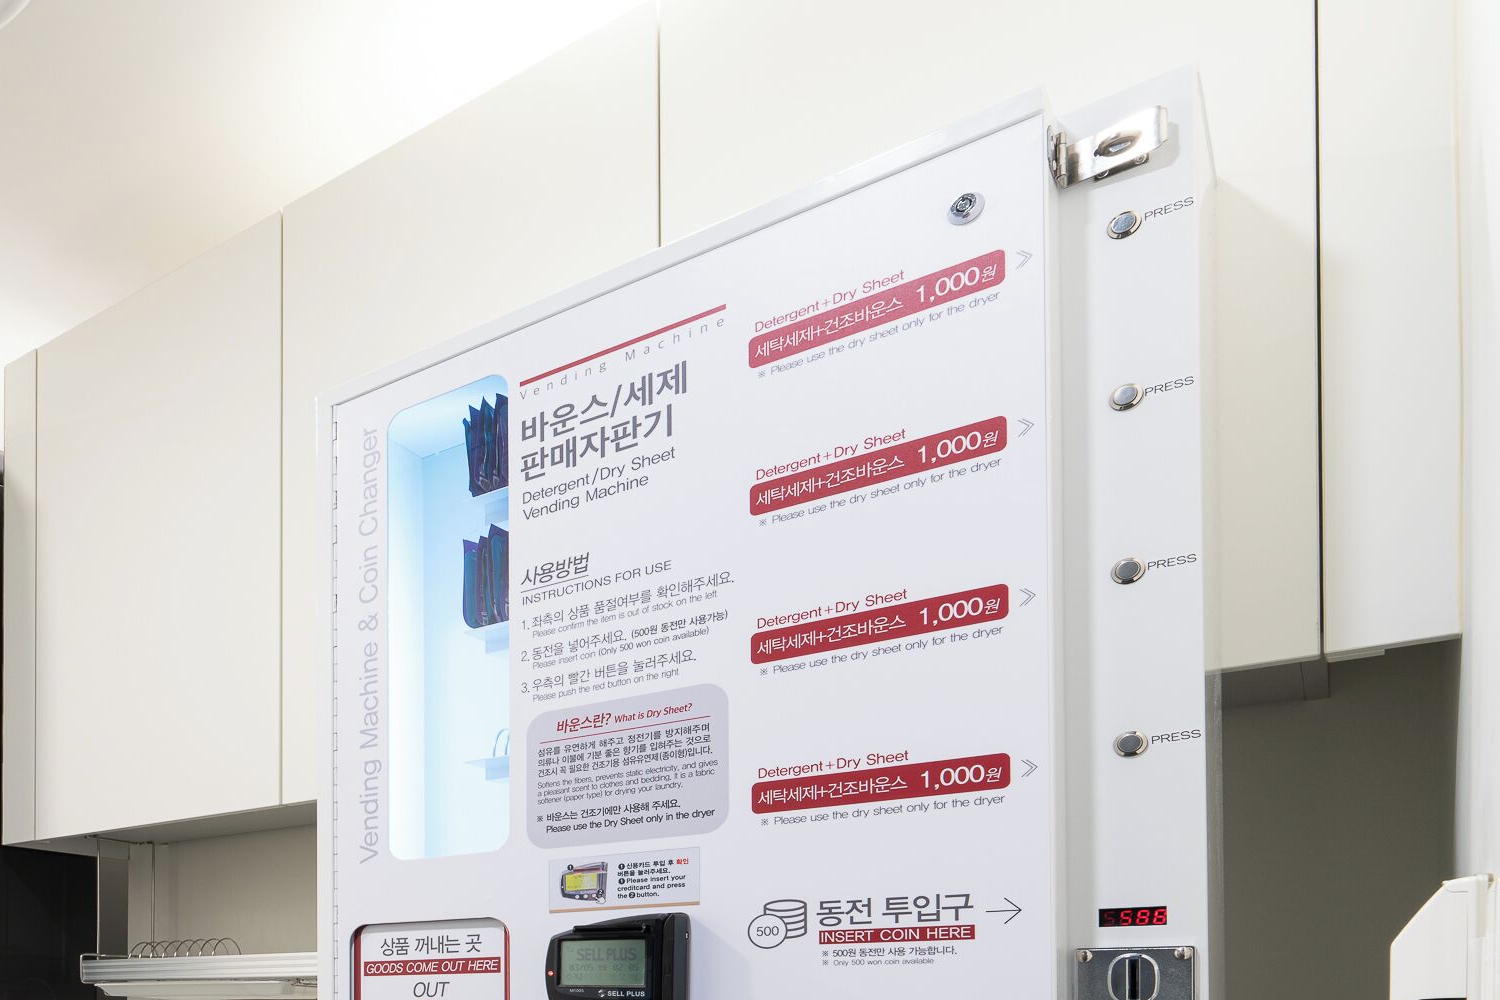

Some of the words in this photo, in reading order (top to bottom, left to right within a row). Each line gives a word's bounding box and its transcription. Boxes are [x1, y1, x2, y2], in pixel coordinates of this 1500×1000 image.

[1144, 196, 1194, 221] PRESS
[754, 288, 856, 333] Detergent+Dry
[862, 269, 904, 294] Sheet
[755, 297, 903, 360] 세탁세제+건조바운스
[915, 264, 998, 302] 1,000원
[520, 361, 607, 400] Vending
[626, 317, 725, 362] Machine
[521, 360, 688, 443] 바운스/세제
[1144, 376, 1194, 397] PRESS
[521, 404, 673, 481] 판매자판기
[756, 446, 858, 481] Detergent+Dry
[864, 428, 906, 450] Sheet
[360, 428, 381, 536] Changer
[522, 464, 626, 505] Detergent/Dry
[631, 447, 676, 471] Sheet
[756, 454, 904, 507] 세탁세제+건조바운스
[917, 430, 999, 464] 1,000원
[522, 494, 580, 520] Vending
[586, 475, 648, 503] Machine
[360, 544, 378, 604] Coin
[520, 552, 589, 586] 사용방법
[522, 575, 611, 605] INSTRUCTIONS
[615, 567, 640, 582] FOR
[645, 560, 671, 575] USE
[1147, 553, 1197, 571] PRESS
[522, 620, 529, 629] 1.
[531, 609, 563, 627] 좌측의
[567, 603, 589, 620] 상품
[593, 589, 651, 614] 품절여부를
[656, 572, 734, 598] 확인해주세요.
[757, 602, 860, 629] Detergent+Dry
[865, 589, 907, 608] Sheet
[359, 613, 378, 633] &
[521, 650, 529, 661] 2.
[532, 641, 564, 660] 동전을
[568, 629, 626, 652] 넣어주세요.
[631, 624, 657, 639] (500원
[660, 618, 686, 632] 동전만
[689, 608, 728, 626] 사용가능)
[757, 614, 906, 656] 세탁세제+건조바운스
[919, 597, 1000, 627] 1,000원
[521, 682, 529, 693] 3.
[532, 673, 563, 691] 우측의
[568, 669, 590, 685] 빨간
[594, 661, 628, 678] 버튼을
[632, 649, 697, 672] 눌러주세요.
[360, 642, 378, 749] Machine
[614, 713, 636, 723] What
[637, 711, 644, 719] is
[646, 709, 661, 718] Dry
[663, 702, 692, 715] Sheet?
[556, 713, 611, 733] 바운스란?
[1151, 729, 1201, 744] PRESS
[758, 756, 861, 779] Detergent+Dry
[866, 750, 909, 765] Sheet
[758, 775, 908, 806] 세탁세제+건조바운스
[920, 764, 1001, 791] 1,000원
[360, 760, 381, 863] Vending
[545, 810, 578, 821] 바운스는
[580, 805, 621, 818] 건조기에만
[623, 801, 650, 814] 사용해
[651, 798, 680, 810] 주세요.
[546, 824, 571, 833] Please
[589, 820, 602, 828] the
[604, 818, 618, 827] Dry
[620, 815, 643, 825] Sheet
[645, 813, 663, 823] only
[665, 812, 673, 820] in
[675, 811, 689, 819] the
[691, 809, 715, 818] dryer
[774, 815, 807, 824] Please
[810, 813, 829, 821] use
[832, 810, 848, 819] the
[851, 808, 869, 818] dry
[873, 804, 902, 815] sheet
[906, 801, 929, 812] only
[933, 800, 948, 809] for
[951, 798, 969, 807] the
[973, 795, 1005, 806] dryer
[816, 898, 872, 926] 동전
[882, 893, 974, 924] 투입구
[381, 937, 410, 956] 상품
[415, 935, 460, 955] 꺼내는
[465, 934, 482, 953] 곳
[756, 925, 779, 937] 500
[821, 929, 874, 943] INSERT
[881, 927, 920, 941] COIN
[927, 926, 971, 939] HERE
[366, 962, 404, 974] GOODS
[406, 961, 438, 973] COME
[441, 960, 465, 972] OUT
[468, 959, 498, 971] HERE
[413, 981, 449, 998] OUT
